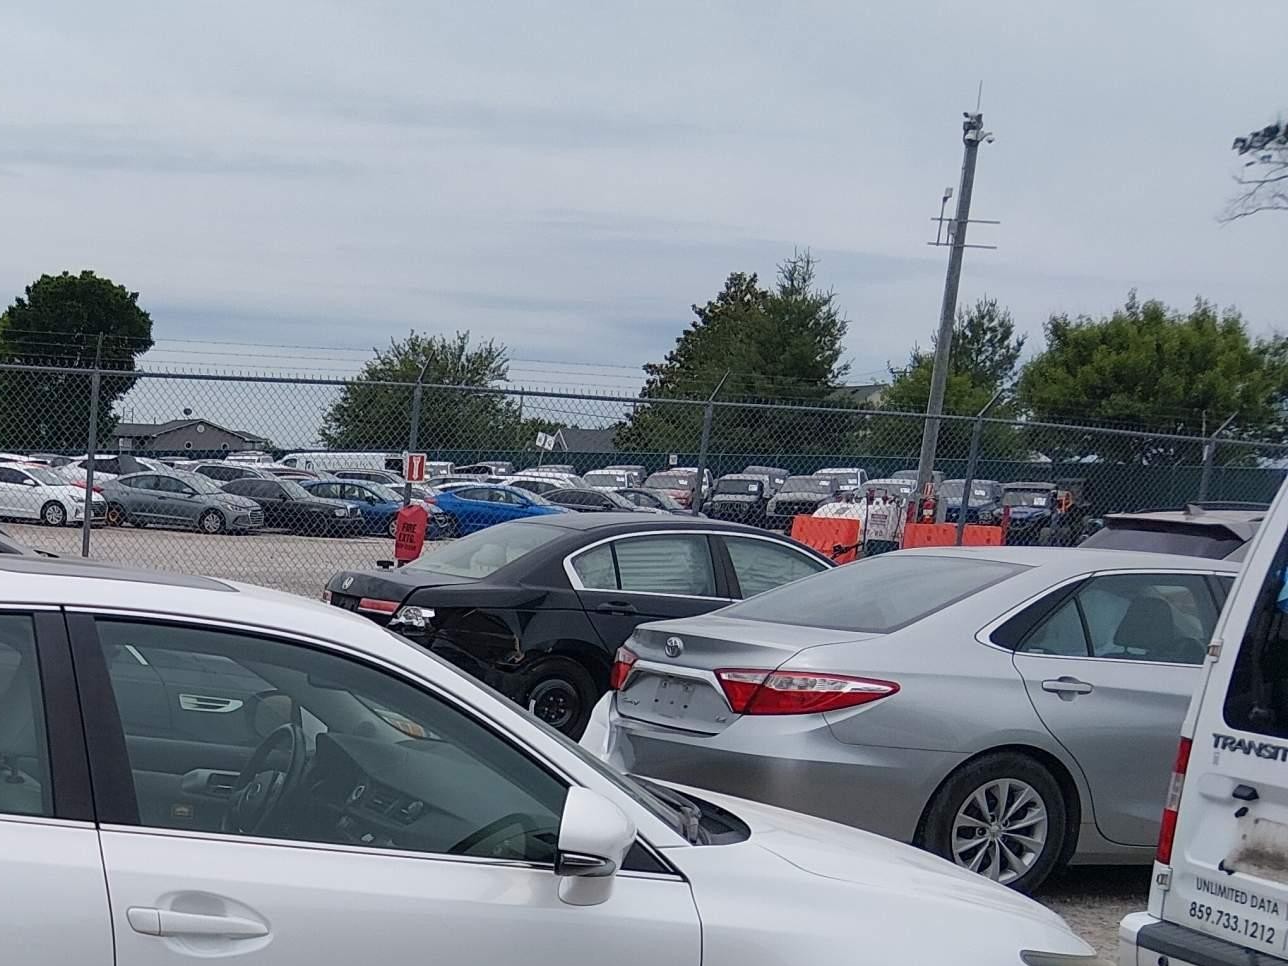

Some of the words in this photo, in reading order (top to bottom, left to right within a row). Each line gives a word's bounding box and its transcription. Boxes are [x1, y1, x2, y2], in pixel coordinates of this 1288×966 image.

[1212, 732, 1288, 763] TRANSIT
[1196, 877, 1248, 905] UNLIMITED
[1250, 894, 1280, 916] DATA
[1189, 901, 1276, 944] 859.733.1212
